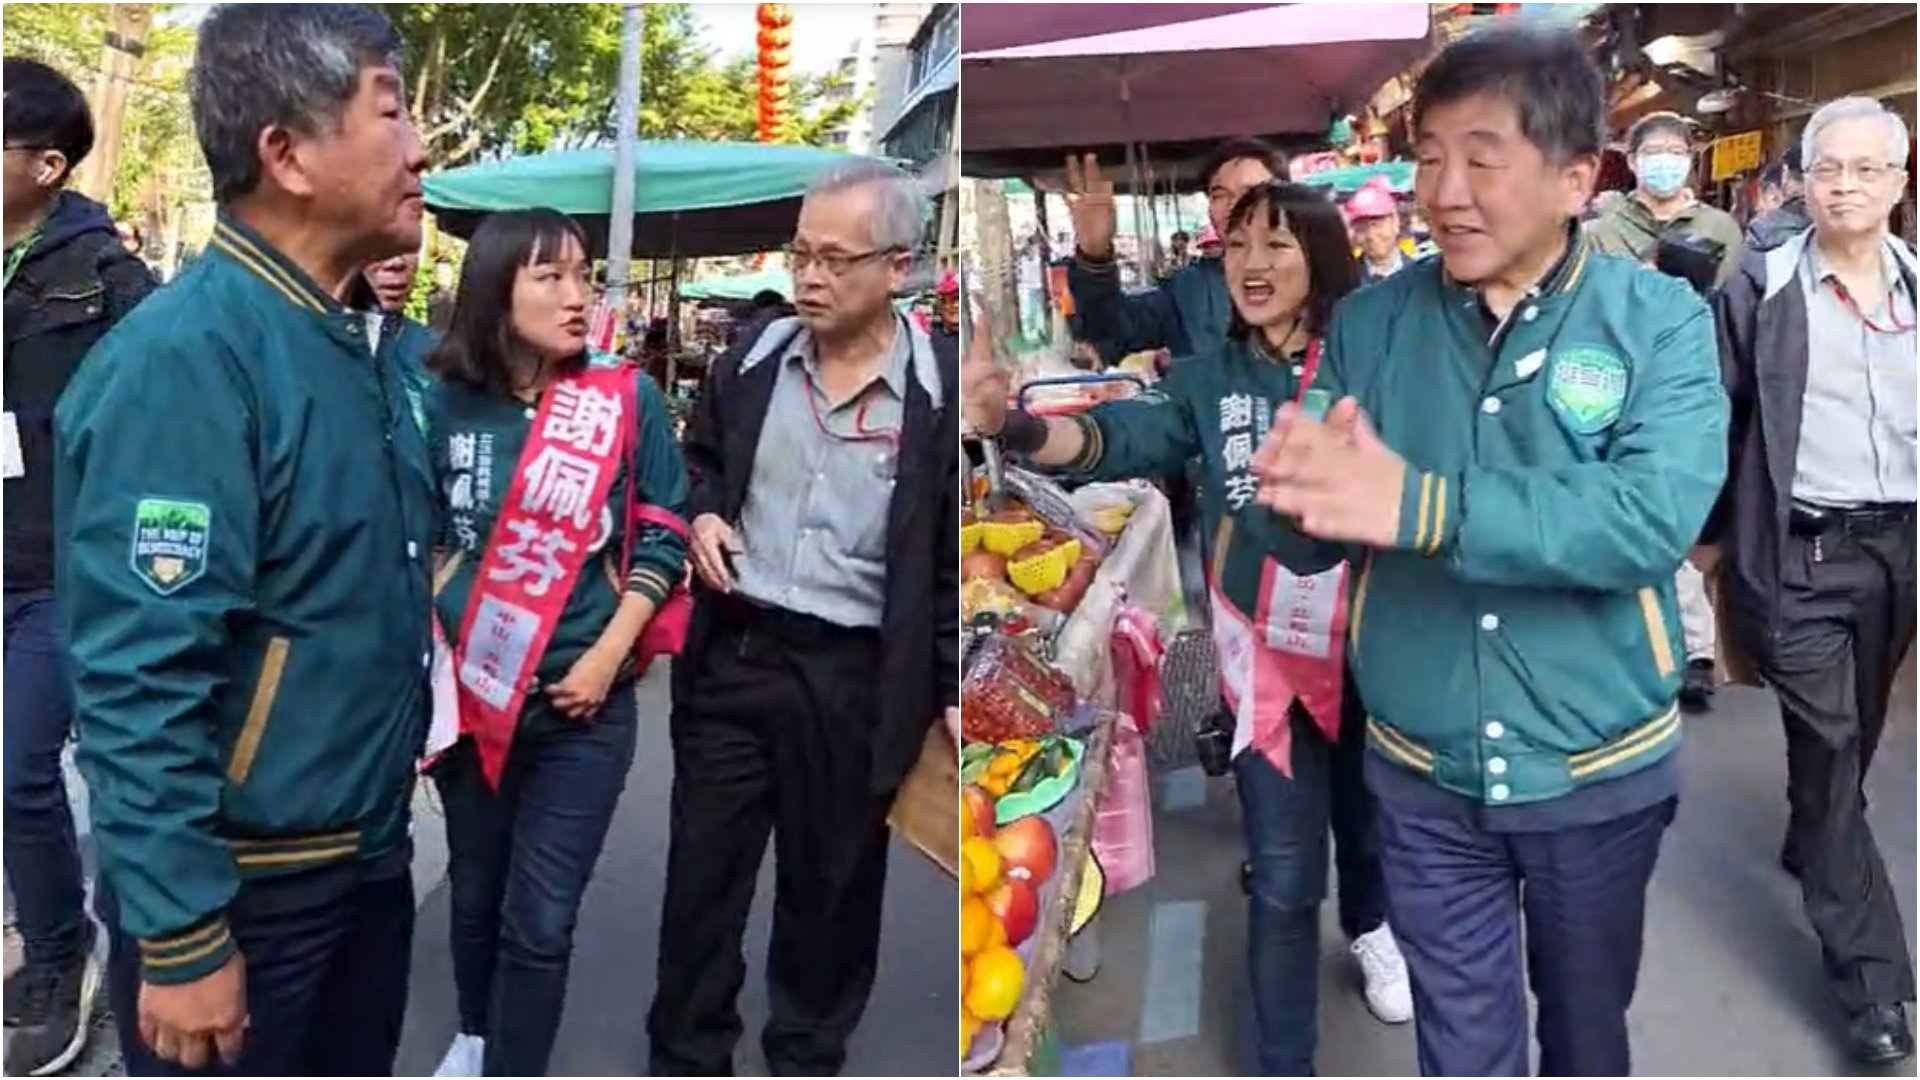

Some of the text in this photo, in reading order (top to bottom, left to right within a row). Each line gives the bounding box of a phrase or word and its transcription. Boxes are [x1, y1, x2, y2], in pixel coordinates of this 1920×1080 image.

[489, 380, 622, 596] 謝佩芬
[1220, 392, 1259, 511] 謝佩芬
